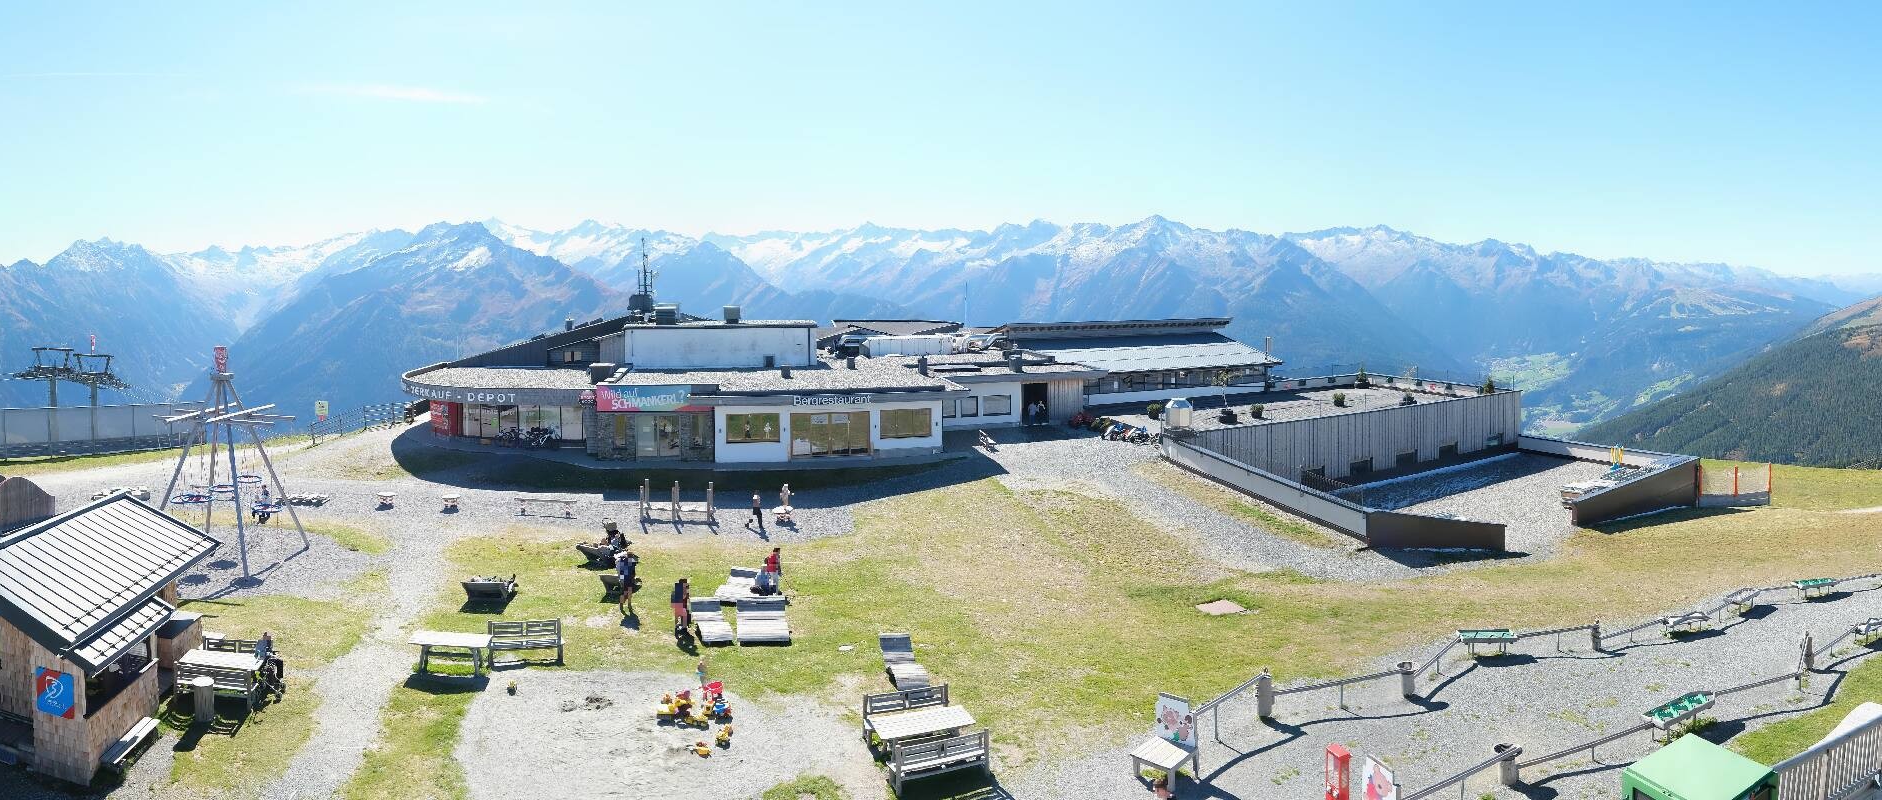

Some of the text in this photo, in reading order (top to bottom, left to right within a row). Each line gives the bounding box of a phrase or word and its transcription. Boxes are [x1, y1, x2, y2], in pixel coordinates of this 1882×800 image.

[467, 392, 516, 403] DEPOT
[623, 387, 638, 399] auf
[793, 394, 872, 406] Bergrestaurant
